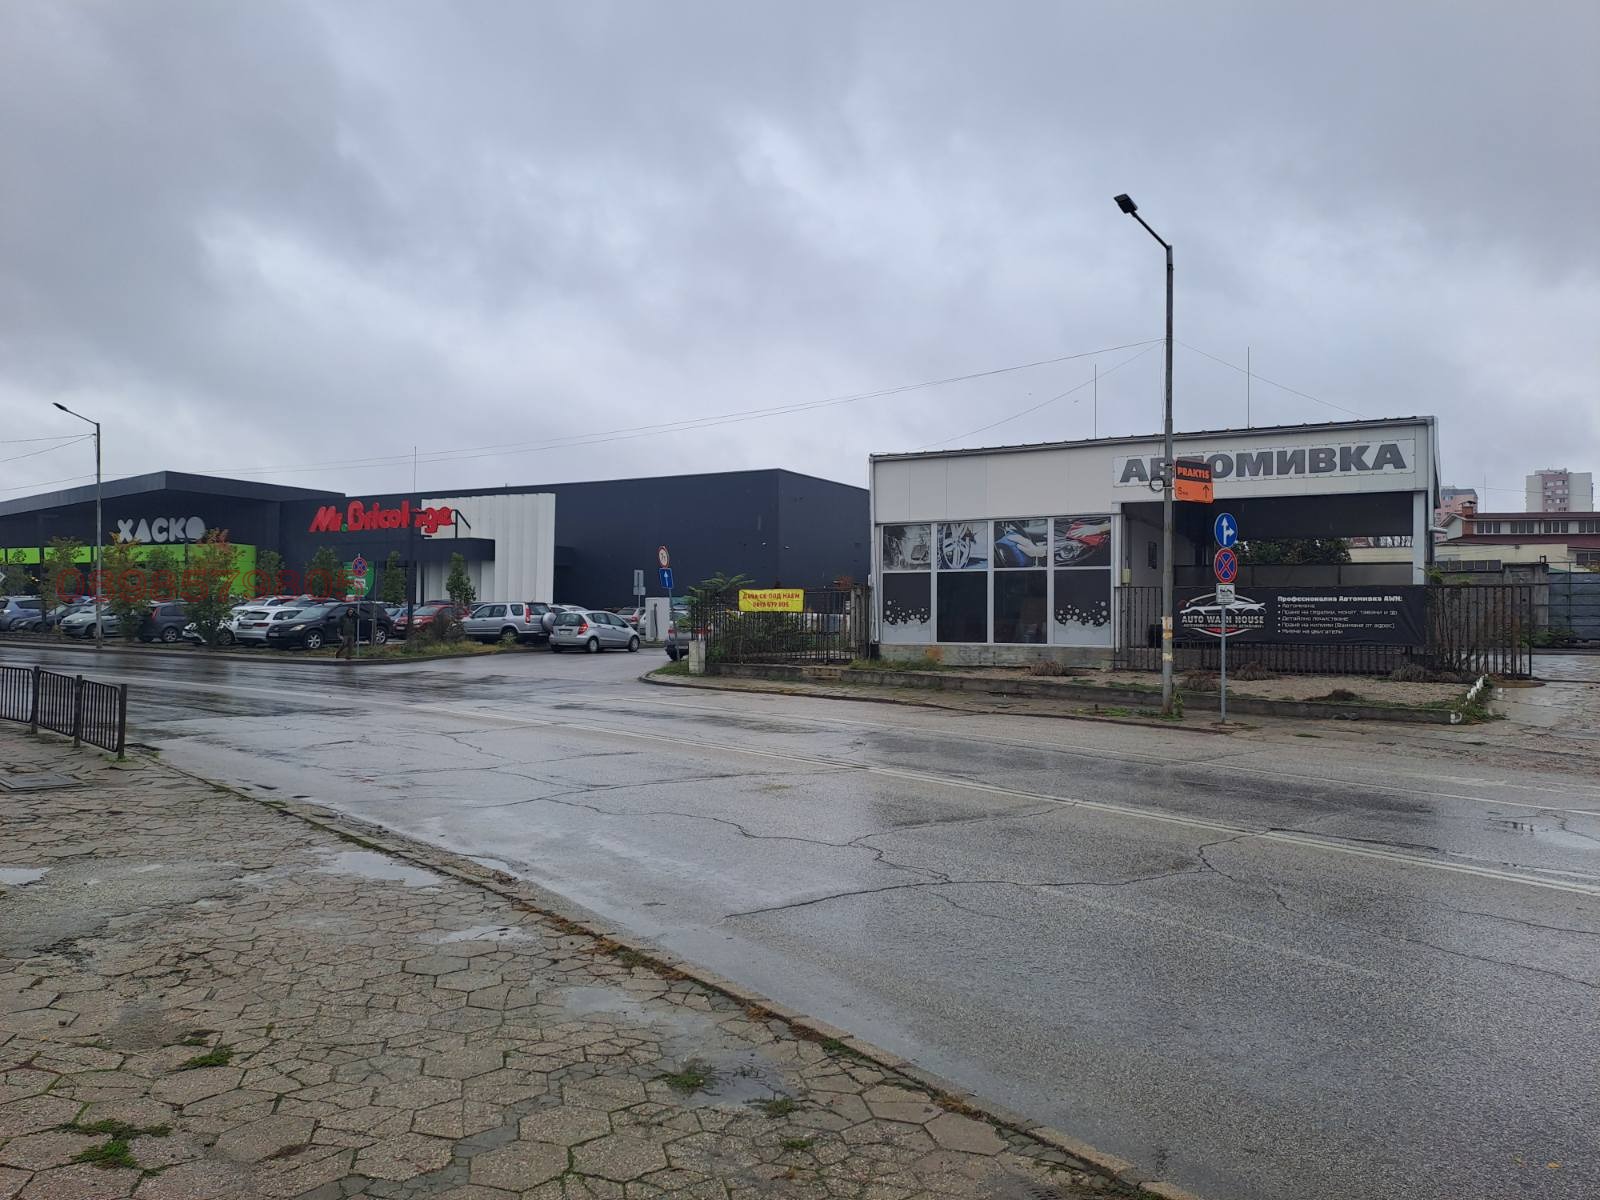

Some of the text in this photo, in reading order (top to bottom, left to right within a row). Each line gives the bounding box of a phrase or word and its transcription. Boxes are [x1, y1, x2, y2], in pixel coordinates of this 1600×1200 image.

[1120, 443, 1407, 482] АВОМИВКА
[1177, 466, 1210, 480] PRAKTIS
[117, 516, 206, 543] ХАСКО
[1181, 615, 1265, 624] AUTO WAH HOUSE
